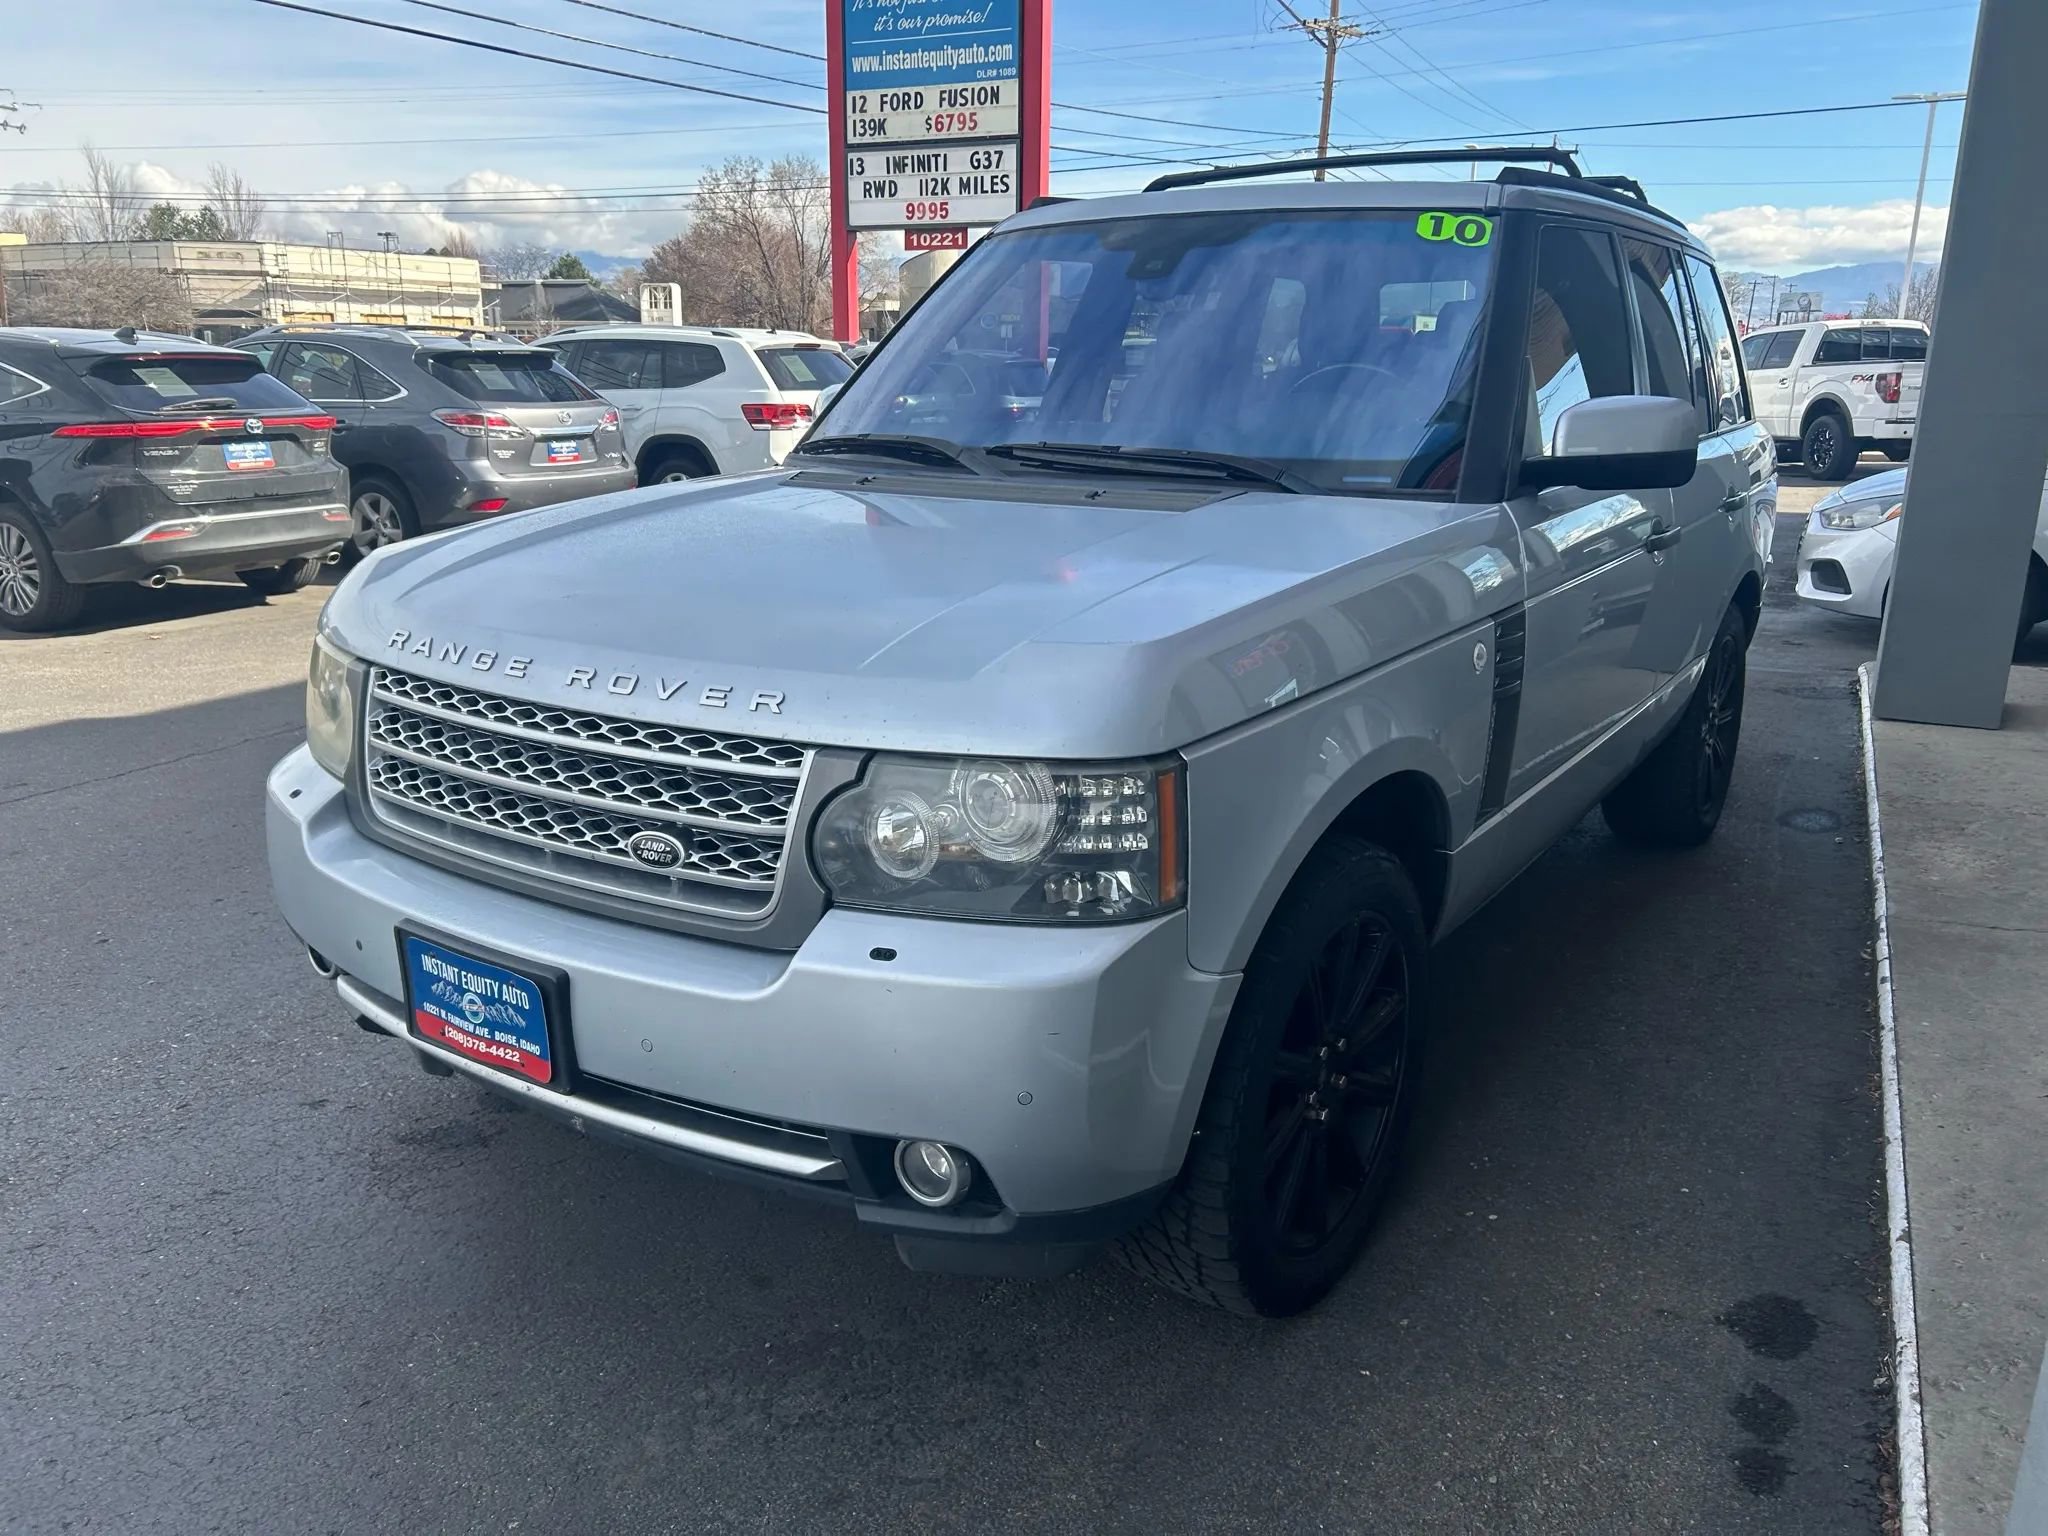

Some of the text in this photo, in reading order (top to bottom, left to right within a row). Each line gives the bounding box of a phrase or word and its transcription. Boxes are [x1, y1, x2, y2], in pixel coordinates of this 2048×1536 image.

[874, 12, 893, 32] it's
[897, 15, 923, 30] our
[922, 2, 993, 34] promise!
[852, 42, 1013, 73] www.instantequityauto.com
[976, 67, 1017, 79] DLR# 1089
[851, 85, 1000, 114] 12 FORD FUSION
[852, 111, 978, 138] 139K $6795
[849, 150, 1004, 176] 13 INFINITI G37
[863, 174, 1010, 199] RWD 112K MILES
[905, 201, 949, 221] 9995
[909, 232, 964, 247] 10221
[1430, 215, 1487, 243] 10
[1851, 374, 1875, 383] FX4
[387, 628, 787, 715] RANGE ROVER
[421, 954, 529, 1010] INSTANT EQUITY AUTO
[423, 1001, 440, 1017] 10221
[447, 1010, 475, 1032] FAIRVIEW
[475, 1023, 491, 1039] AVE.
[494, 1028, 519, 1048] BOISE,
[519, 1039, 541, 1056] IDAHO
[445, 1025, 520, 1062] (208)378-4422
